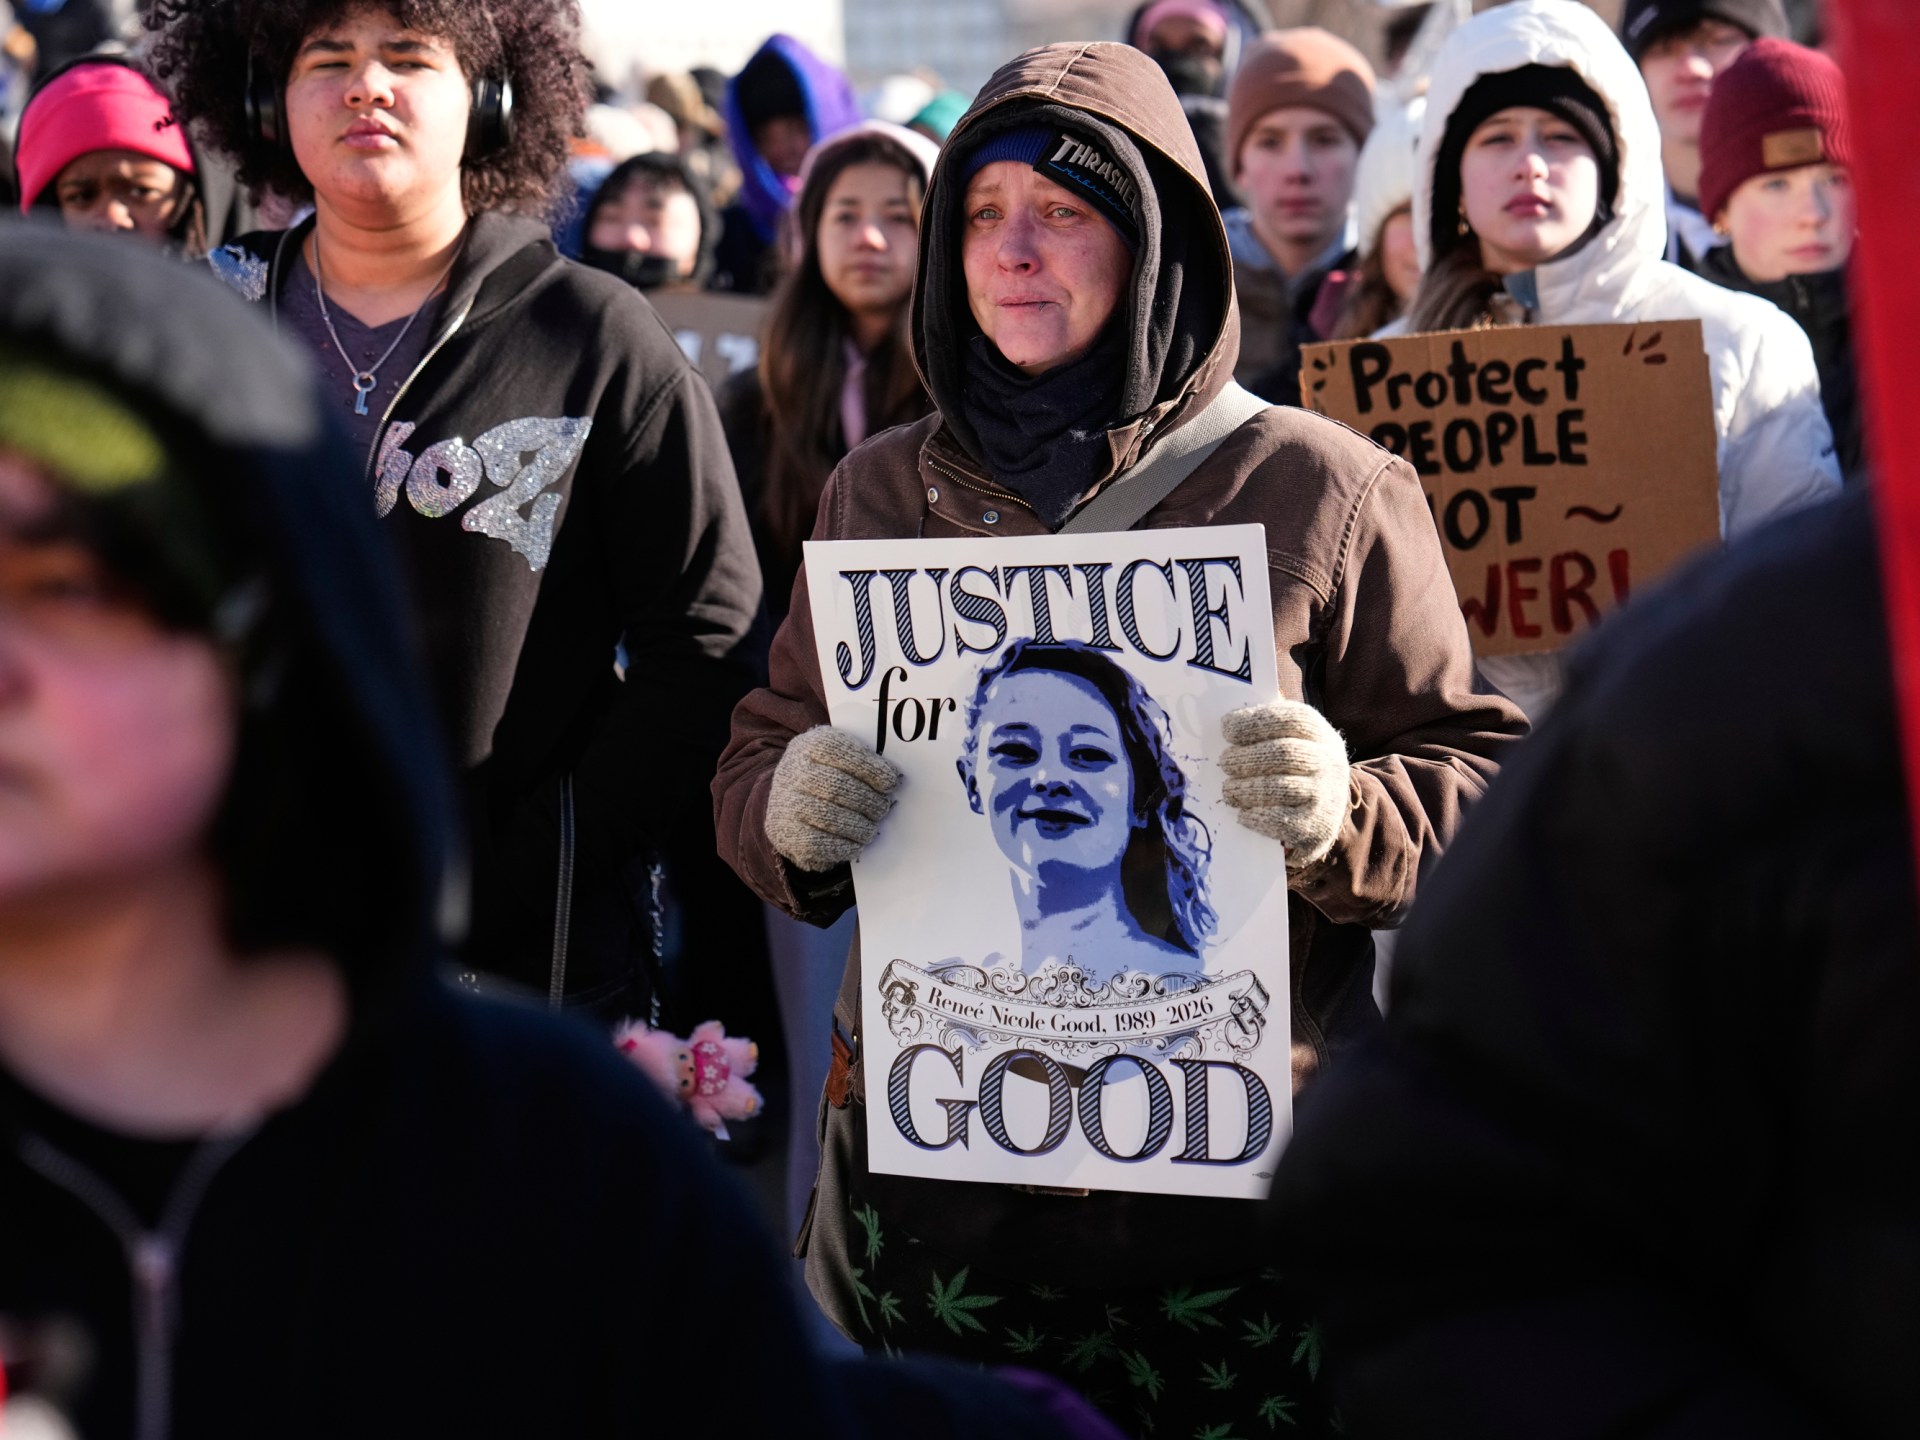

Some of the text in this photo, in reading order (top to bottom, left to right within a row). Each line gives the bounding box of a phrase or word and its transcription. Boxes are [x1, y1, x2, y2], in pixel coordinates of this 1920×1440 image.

[1349, 336, 1585, 413] Protect
[1369, 410, 1588, 475] PEOPLE
[1427, 486, 1536, 550] OT
[836, 556, 1252, 690] JUSTICE
[1460, 549, 1630, 639] WER!
[872, 666, 956, 755] for
[928, 986, 984, 1020] Reneé
[989, 1005, 1046, 1030] Nicole
[1050, 1013, 1107, 1037] Good,
[888, 1044, 1272, 1166] GOOD
